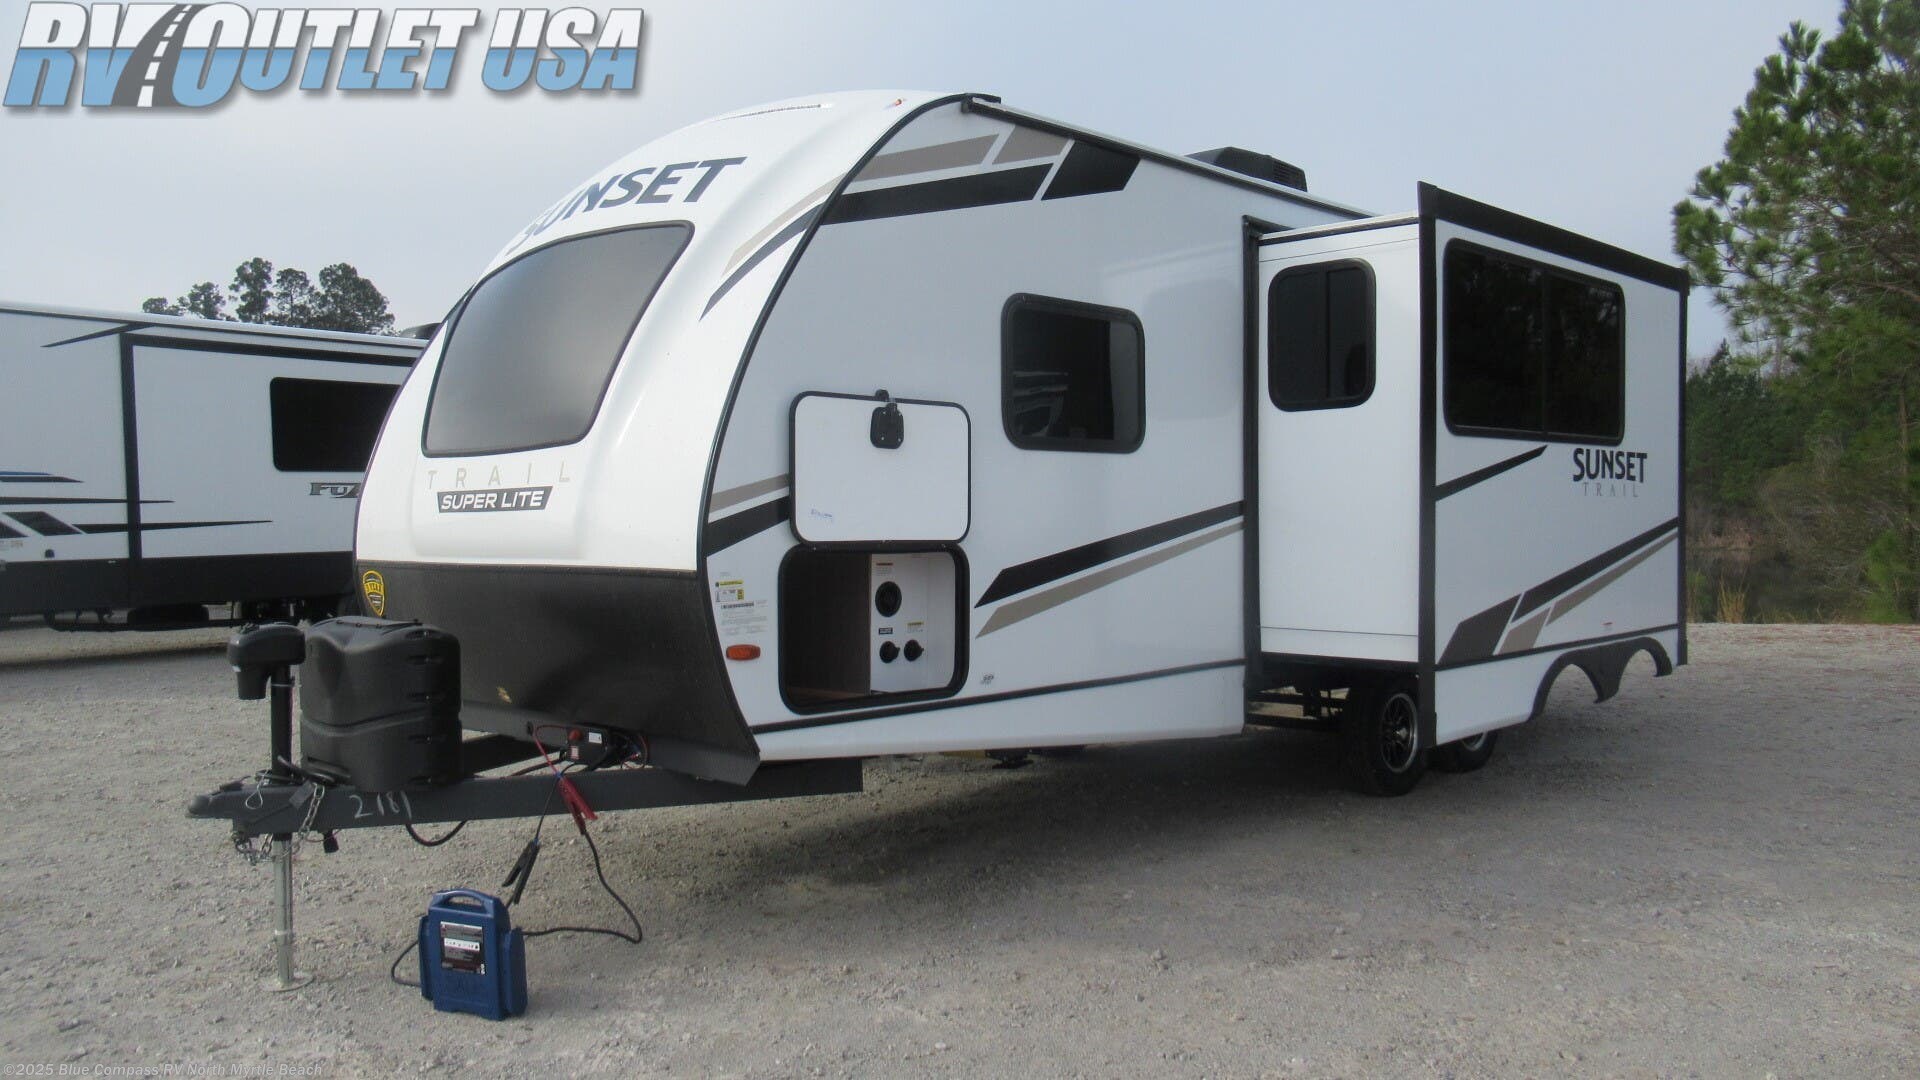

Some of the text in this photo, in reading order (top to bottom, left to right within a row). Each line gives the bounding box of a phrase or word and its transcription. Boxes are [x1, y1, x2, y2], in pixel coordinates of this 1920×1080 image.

[504, 156, 748, 257] SUNSET
[427, 461, 571, 490] TRAIL
[1573, 448, 1648, 483] SUNSET
[441, 490, 544, 510] SUPER LITE
[1582, 482, 1640, 498] TRAIL
